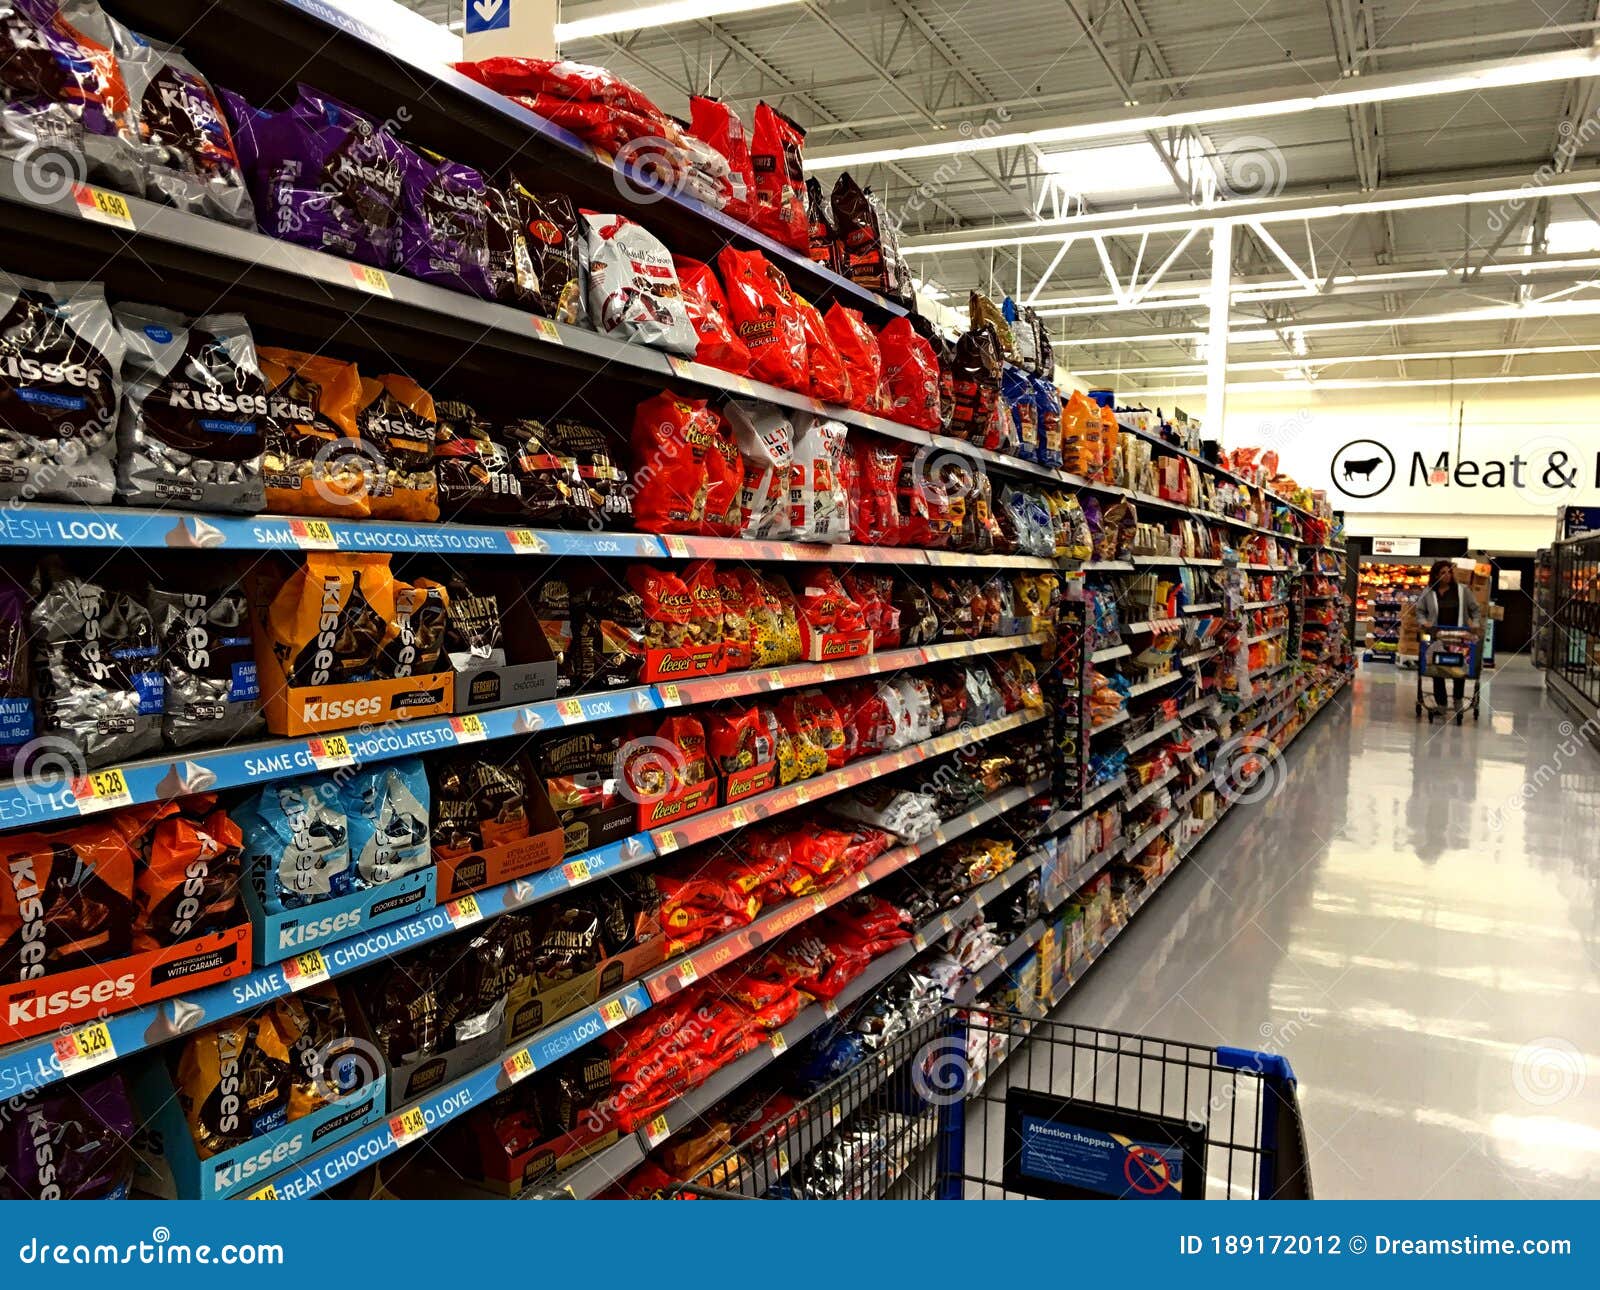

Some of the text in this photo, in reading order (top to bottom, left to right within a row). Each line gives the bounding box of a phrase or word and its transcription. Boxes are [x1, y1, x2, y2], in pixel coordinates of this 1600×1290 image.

[169, 390, 267, 415] Kisses
[1409, 450, 1578, 489] Meat &
[57, 520, 124, 540] LOOK
[354, 531, 443, 549] CHOCOLATES
[443, 534, 462, 548] TO
[462, 536, 498, 549] LOVE!
[311, 580, 342, 686] Kisses
[658, 654, 692, 673] Reese's
[0, 703, 29, 716] AMILY
[3, 714, 21, 724] BAG
[303, 695, 382, 723] Kisses
[587, 701, 614, 716] LOOK
[348, 731, 436, 758] CHOCOLATES
[435, 726, 454, 743] TO
[244, 753, 293, 776] SAME
[728, 779, 751, 796] Reese's
[602, 815, 632, 831] ASSORTMENT
[651, 799, 681, 820] Reese's
[9, 857, 46, 981] Kisses
[279, 908, 362, 949] Kisses
[334, 920, 426, 966] CHOCOLATES
[425, 914, 444, 932] TO
[167, 957, 224, 978] WITH CARAMEL
[9, 973, 135, 1026] Kisses
[232, 973, 281, 1004] SAME
[79, 1028, 107, 1053] 5.28
[542, 1018, 600, 1058] FRESH LOOK
[217, 1031, 239, 1133] Kisses
[438, 1087, 473, 1118] LOVE!
[1029, 1123, 1115, 1150] Attention shoppers
[27, 1110, 61, 1200] Kisse
[215, 1134, 303, 1192] Kisses
[276, 1129, 398, 1200] GREAT CHOCOLA
